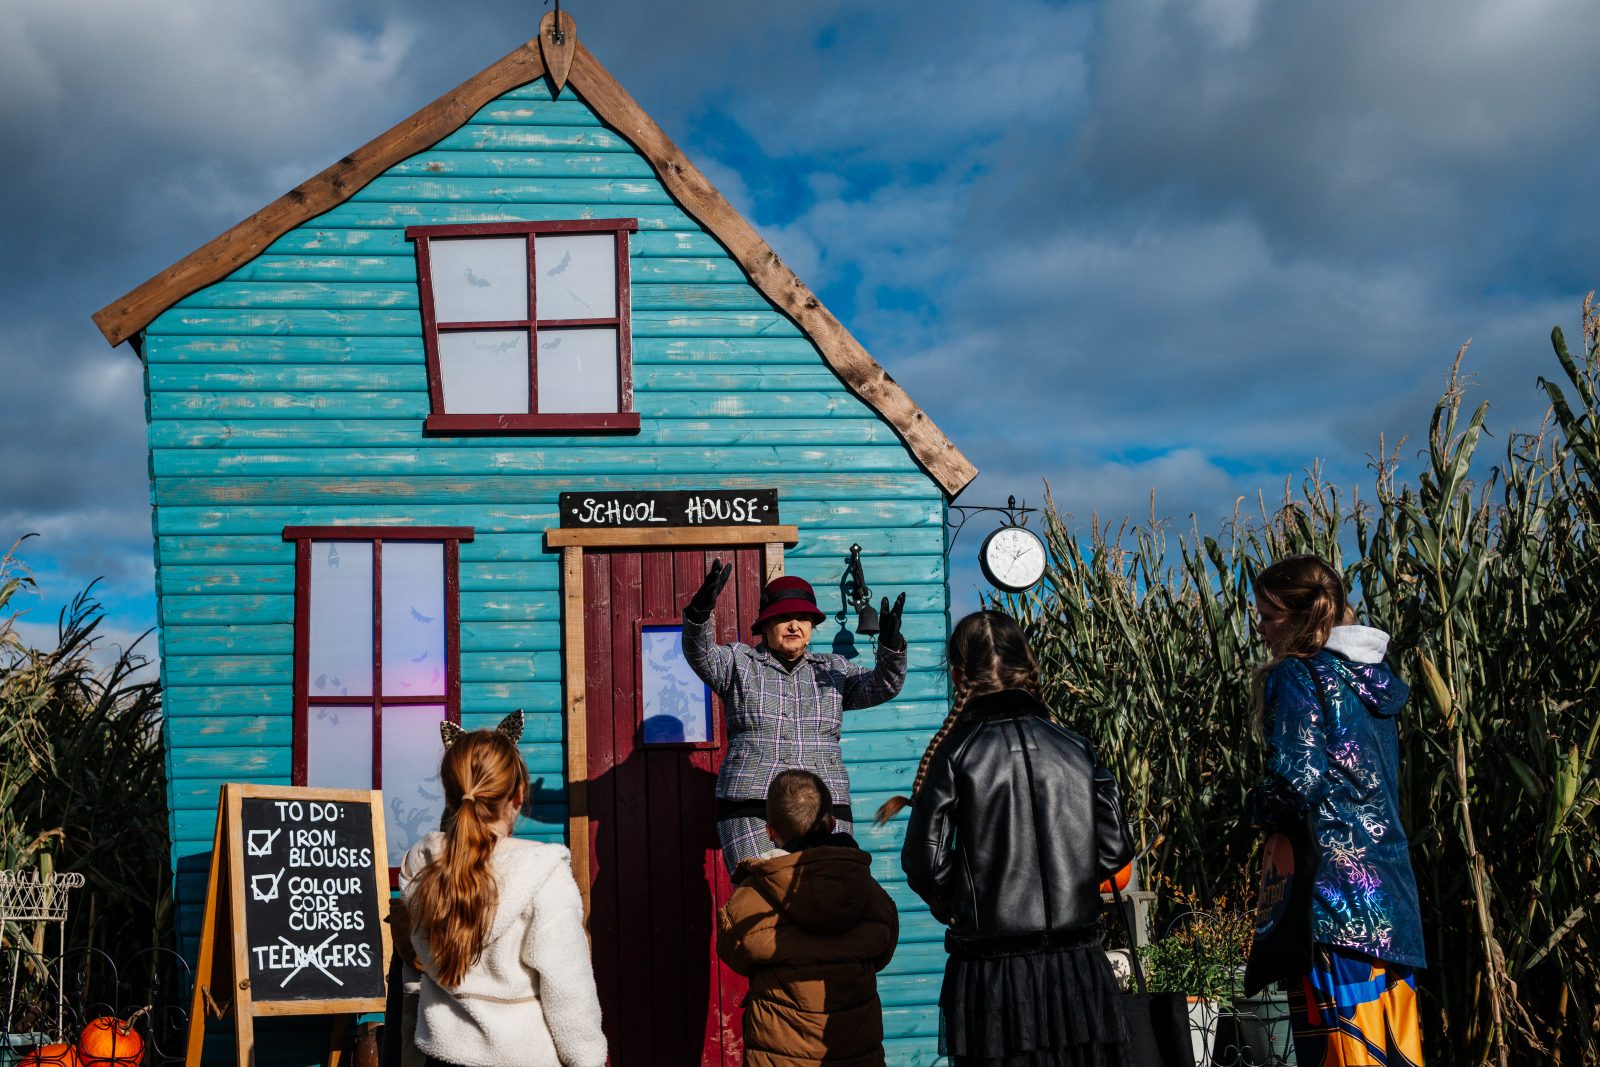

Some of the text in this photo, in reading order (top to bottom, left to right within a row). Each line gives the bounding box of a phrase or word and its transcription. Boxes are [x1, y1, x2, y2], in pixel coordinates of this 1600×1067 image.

[578, 496, 762, 525] SCHOOL HOUSE
[274, 801, 345, 822] TO DO:
[289, 829, 336, 847] IRON
[289, 847, 372, 868] BLOUSES
[287, 876, 362, 895] COLOUR
[289, 895, 340, 912] CODE
[288, 911, 365, 931] CURSES
[252, 943, 372, 970] TEENAGERS
